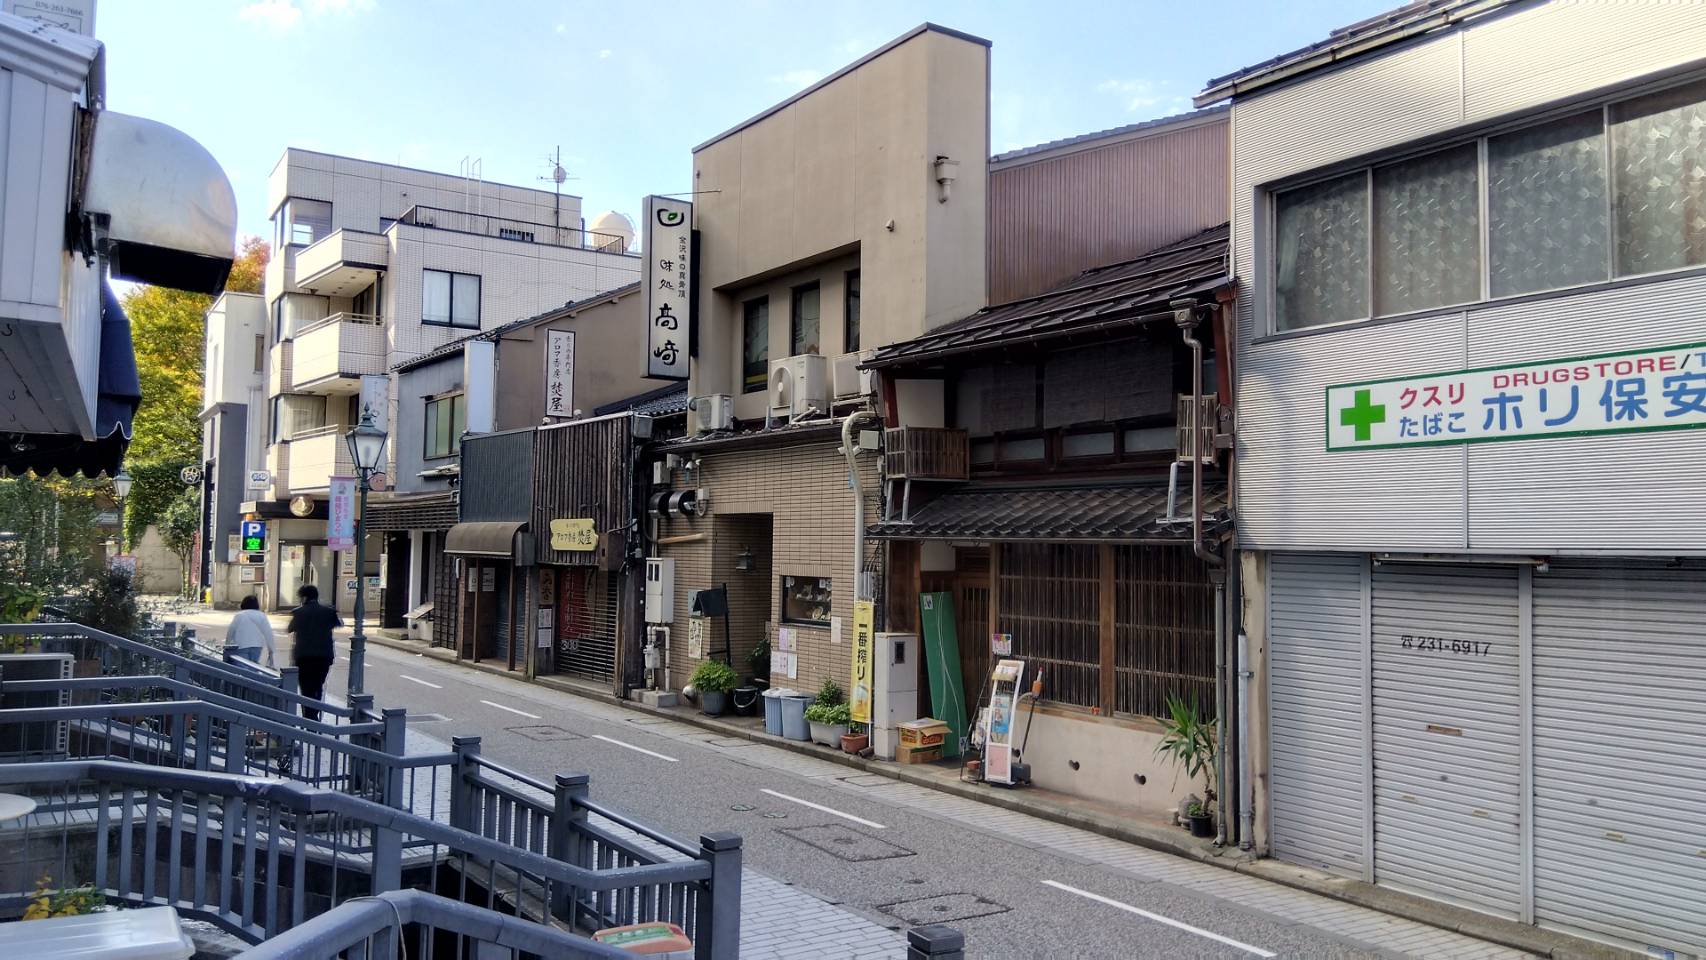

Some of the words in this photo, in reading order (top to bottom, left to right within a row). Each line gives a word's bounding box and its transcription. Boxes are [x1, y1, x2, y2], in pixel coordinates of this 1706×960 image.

[1400, 382, 1465, 410] クスリ
[1400, 412, 1466, 437] たばこ
[248, 523, 261, 537] P
[857, 623, 868, 681] 一番搾り
[1418, 636, 1492, 656] 231-6917
